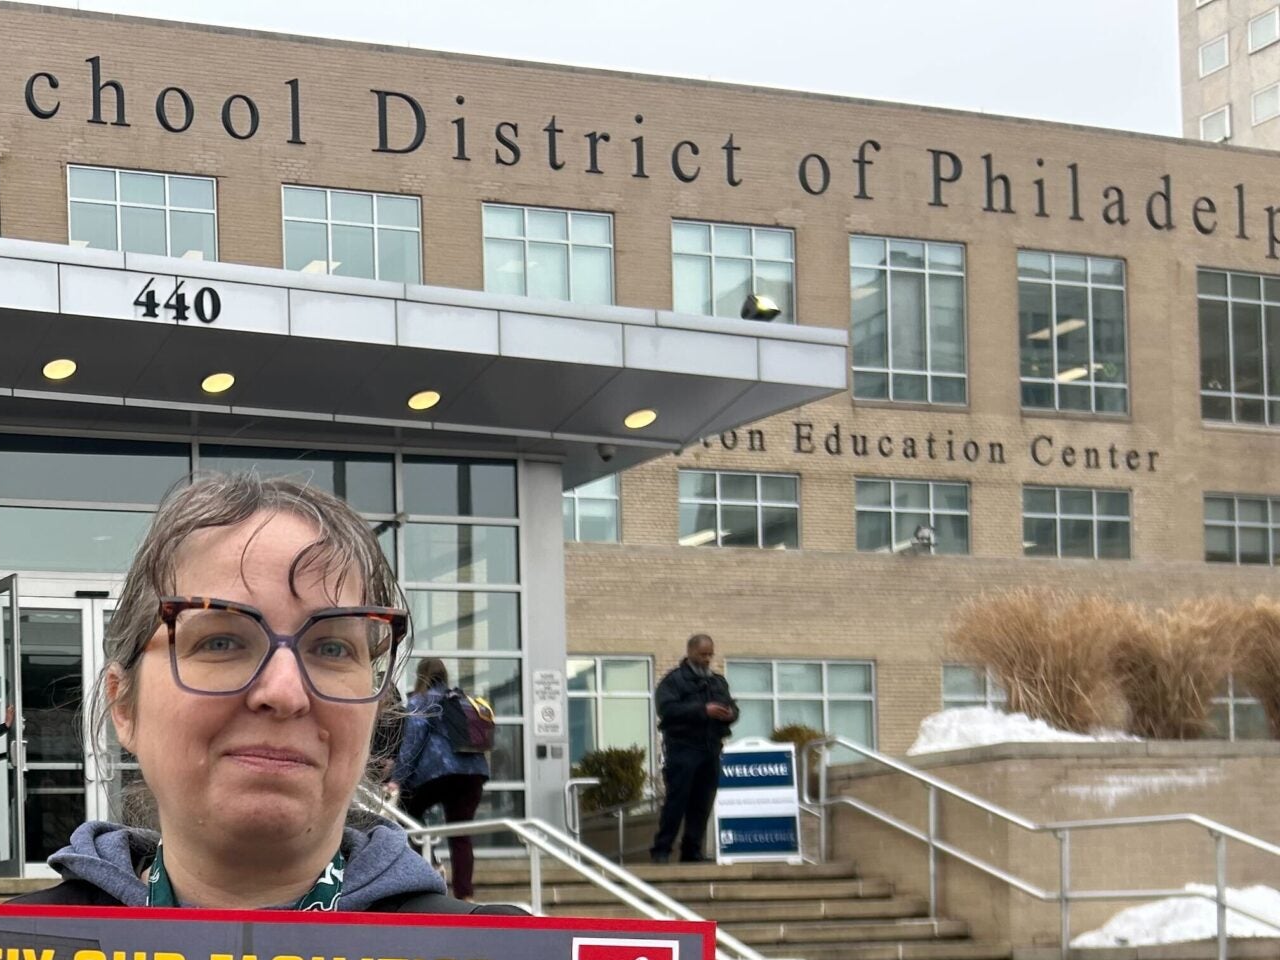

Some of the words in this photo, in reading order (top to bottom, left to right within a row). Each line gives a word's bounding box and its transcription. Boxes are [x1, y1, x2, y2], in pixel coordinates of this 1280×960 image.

[371, 89, 743, 188] District
[798, 140, 881, 200] of
[133, 277, 221, 324] 440
[794, 422, 1006, 464] Education
[1030, 436, 1160, 473] Center
[722, 763, 789, 778] WELCOME
